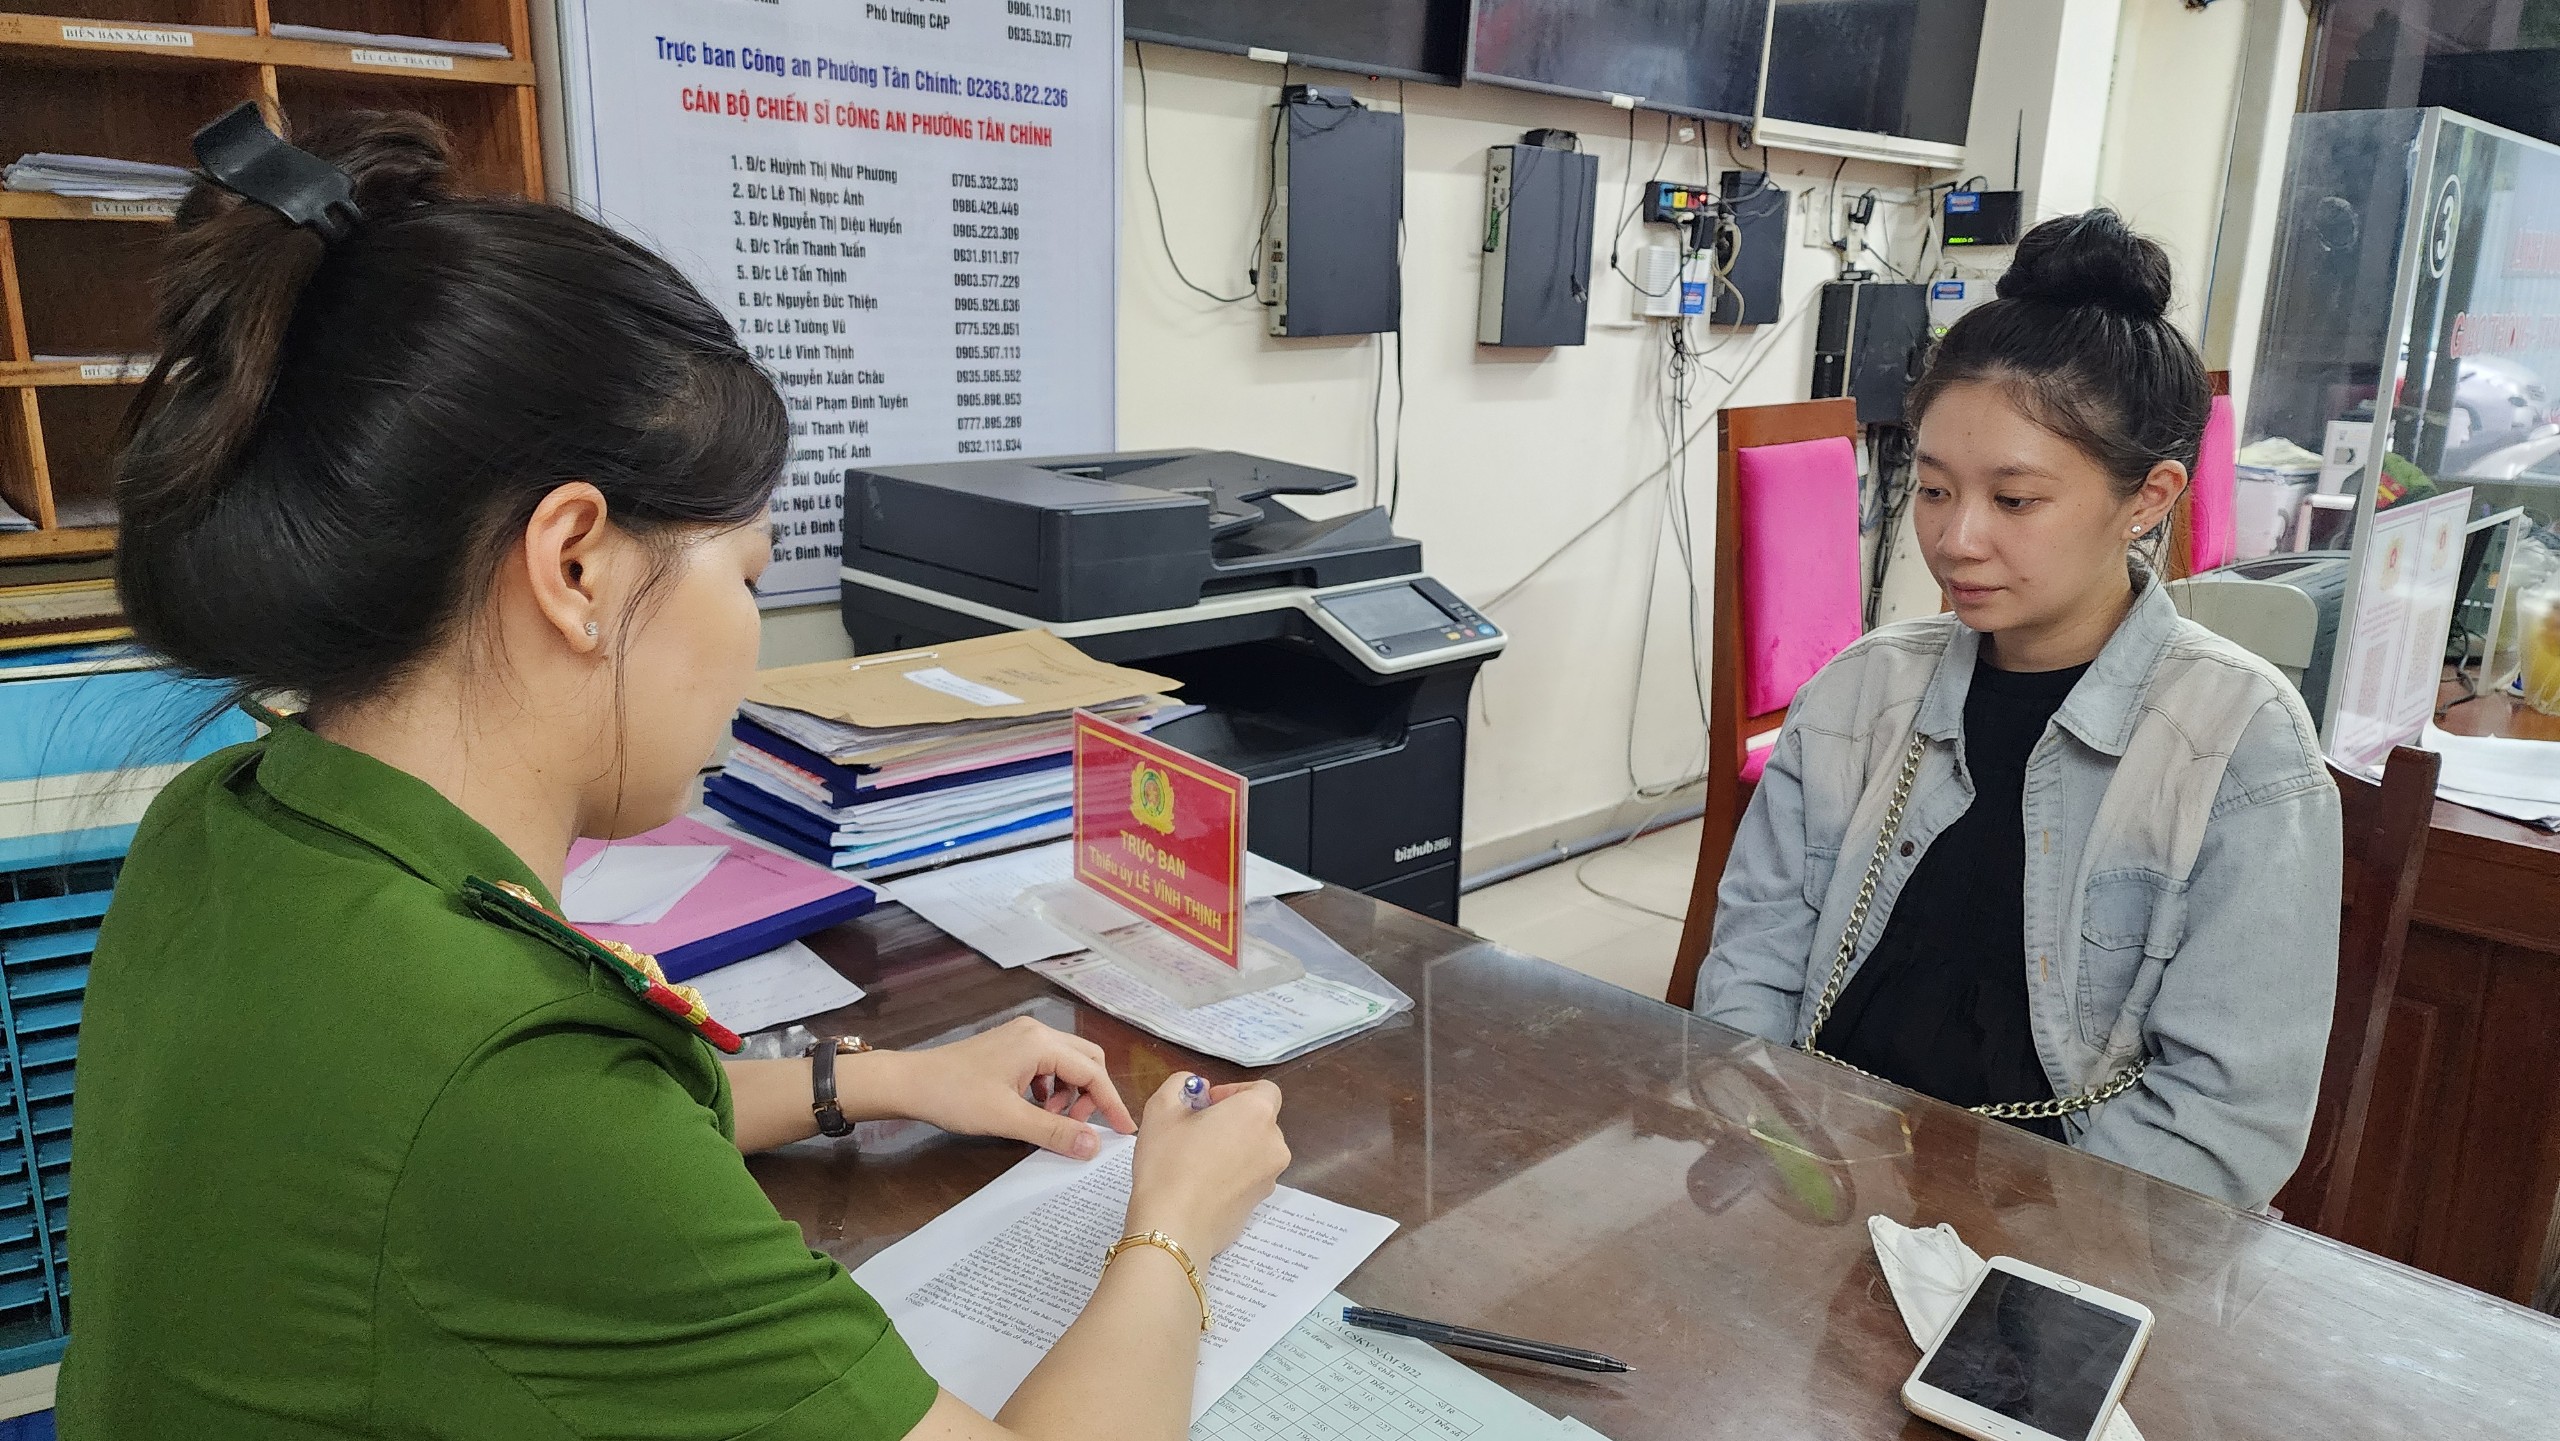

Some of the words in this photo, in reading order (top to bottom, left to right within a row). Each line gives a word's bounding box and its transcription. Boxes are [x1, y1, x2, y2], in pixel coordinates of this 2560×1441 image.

[929, 13, 950, 30] CAP
[155, 33, 188, 44] MINH
[655, 36, 697, 67] Trực
[703, 42, 736, 69] ban
[742, 48, 786, 77] Công
[791, 57, 811, 78] an
[817, 57, 878, 88] Phường
[883, 65, 910, 90] Tân
[915, 69, 962, 96] Chính:
[966, 76, 1069, 108] 02363.822.236
[682, 84, 721, 114] CÁN
[726, 89, 750, 123] BỘ
[756, 92, 808, 123] CHIẾN
[836, 100, 880, 131] CÔNG
[885, 110, 907, 133] AN
[912, 111, 973, 140] PHƯỜNG
[977, 116, 1005, 143] TÂN
[1010, 120, 1053, 147] CHÍNH
[731, 154, 743, 171] 1.
[809, 160, 828, 181] Thị
[732, 182, 745, 199] 2.
[771, 184, 785, 201] Lê
[788, 186, 807, 207] Thị
[733, 210, 746, 226] 3.
[820, 215, 838, 236] Thị
[2437, 194, 2455, 261] 3
[736, 237, 748, 254] 4.
[802, 240, 837, 258] Thanh
[736, 264, 749, 280] 5.
[775, 265, 789, 281] Lê
[816, 266, 847, 287] Thịnh
[777, 318, 791, 335] Lê
[778, 344, 792, 361] Lê
[811, 421, 845, 436] Thanh
[850, 443, 872, 459] Anh
[819, 494, 831, 510] Lê
[794, 520, 807, 537] Lê
[1120, 829, 1155, 864] TRỰC
[1158, 848, 1186, 880] BAN
[1394, 840, 1433, 863] bizhub
[1088, 845, 1118, 876] Thiếu
[1135, 867, 1150, 894] LÊ
[1153, 877, 1181, 910] VĨNH
[1184, 895, 1222, 931] THỊNH
[1329, 1371, 1345, 1383] 260
[1397, 1359, 1423, 1379] 2022
[1359, 1391, 1376, 1402] 318
[1343, 1401, 1360, 1413] 200
[1266, 1411, 1281, 1422] 166
[1250, 1421, 1266, 1433] 182
[1376, 1422, 1392, 1433] 223
